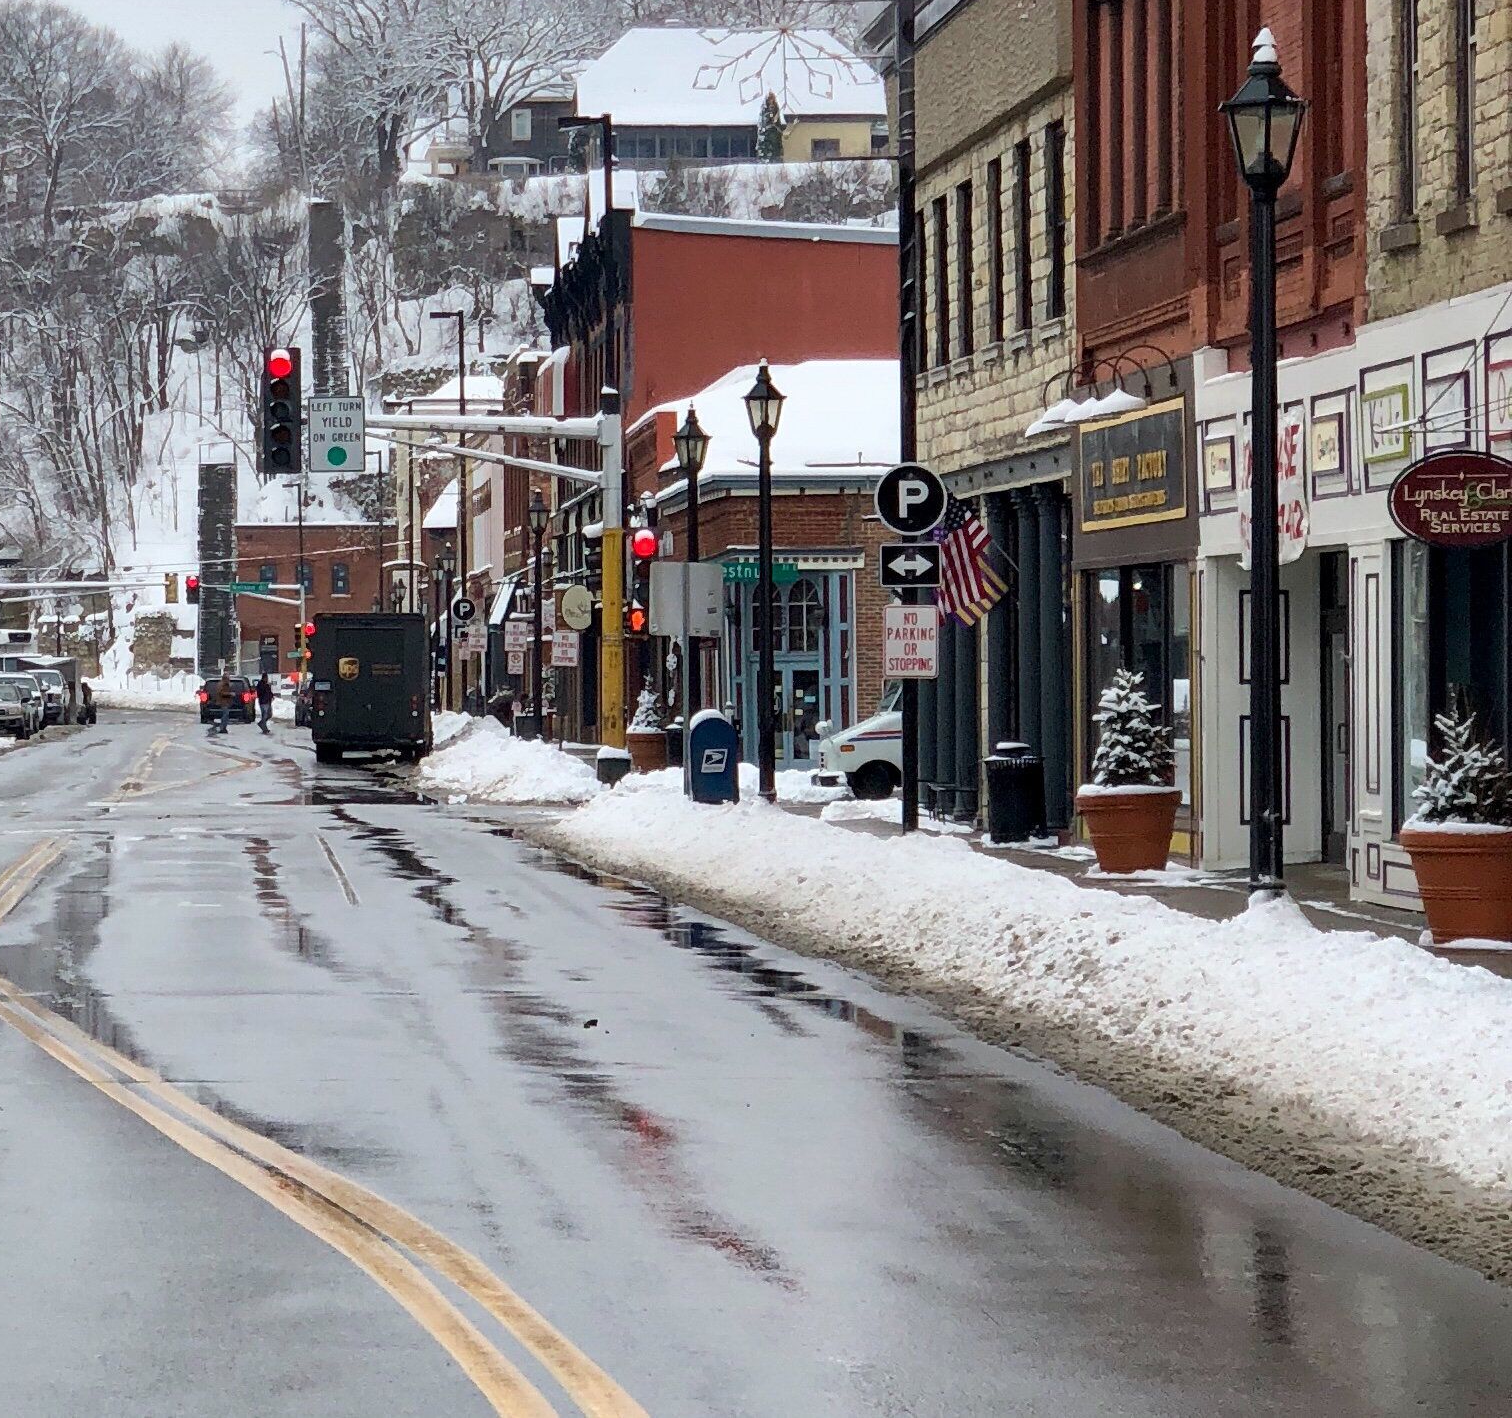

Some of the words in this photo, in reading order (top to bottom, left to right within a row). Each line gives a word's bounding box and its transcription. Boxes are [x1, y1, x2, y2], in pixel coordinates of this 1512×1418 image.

[311, 402, 333, 412] LEFT
[338, 401, 362, 412] TURN
[321, 416, 353, 428] YIELD
[312, 433, 326, 443] ON
[331, 432, 361, 443] GREEN
[897, 479, 930, 519] P
[1403, 479, 1468, 508] Lynskey
[1476, 478, 1512, 500] Clar
[722, 564, 760, 579] estnu
[459, 602, 471, 617] P
[902, 612, 918, 626] NO
[886, 627, 936, 641] PARKING
[903, 642, 918, 656] OR
[888, 657, 934, 672] STOPPING
